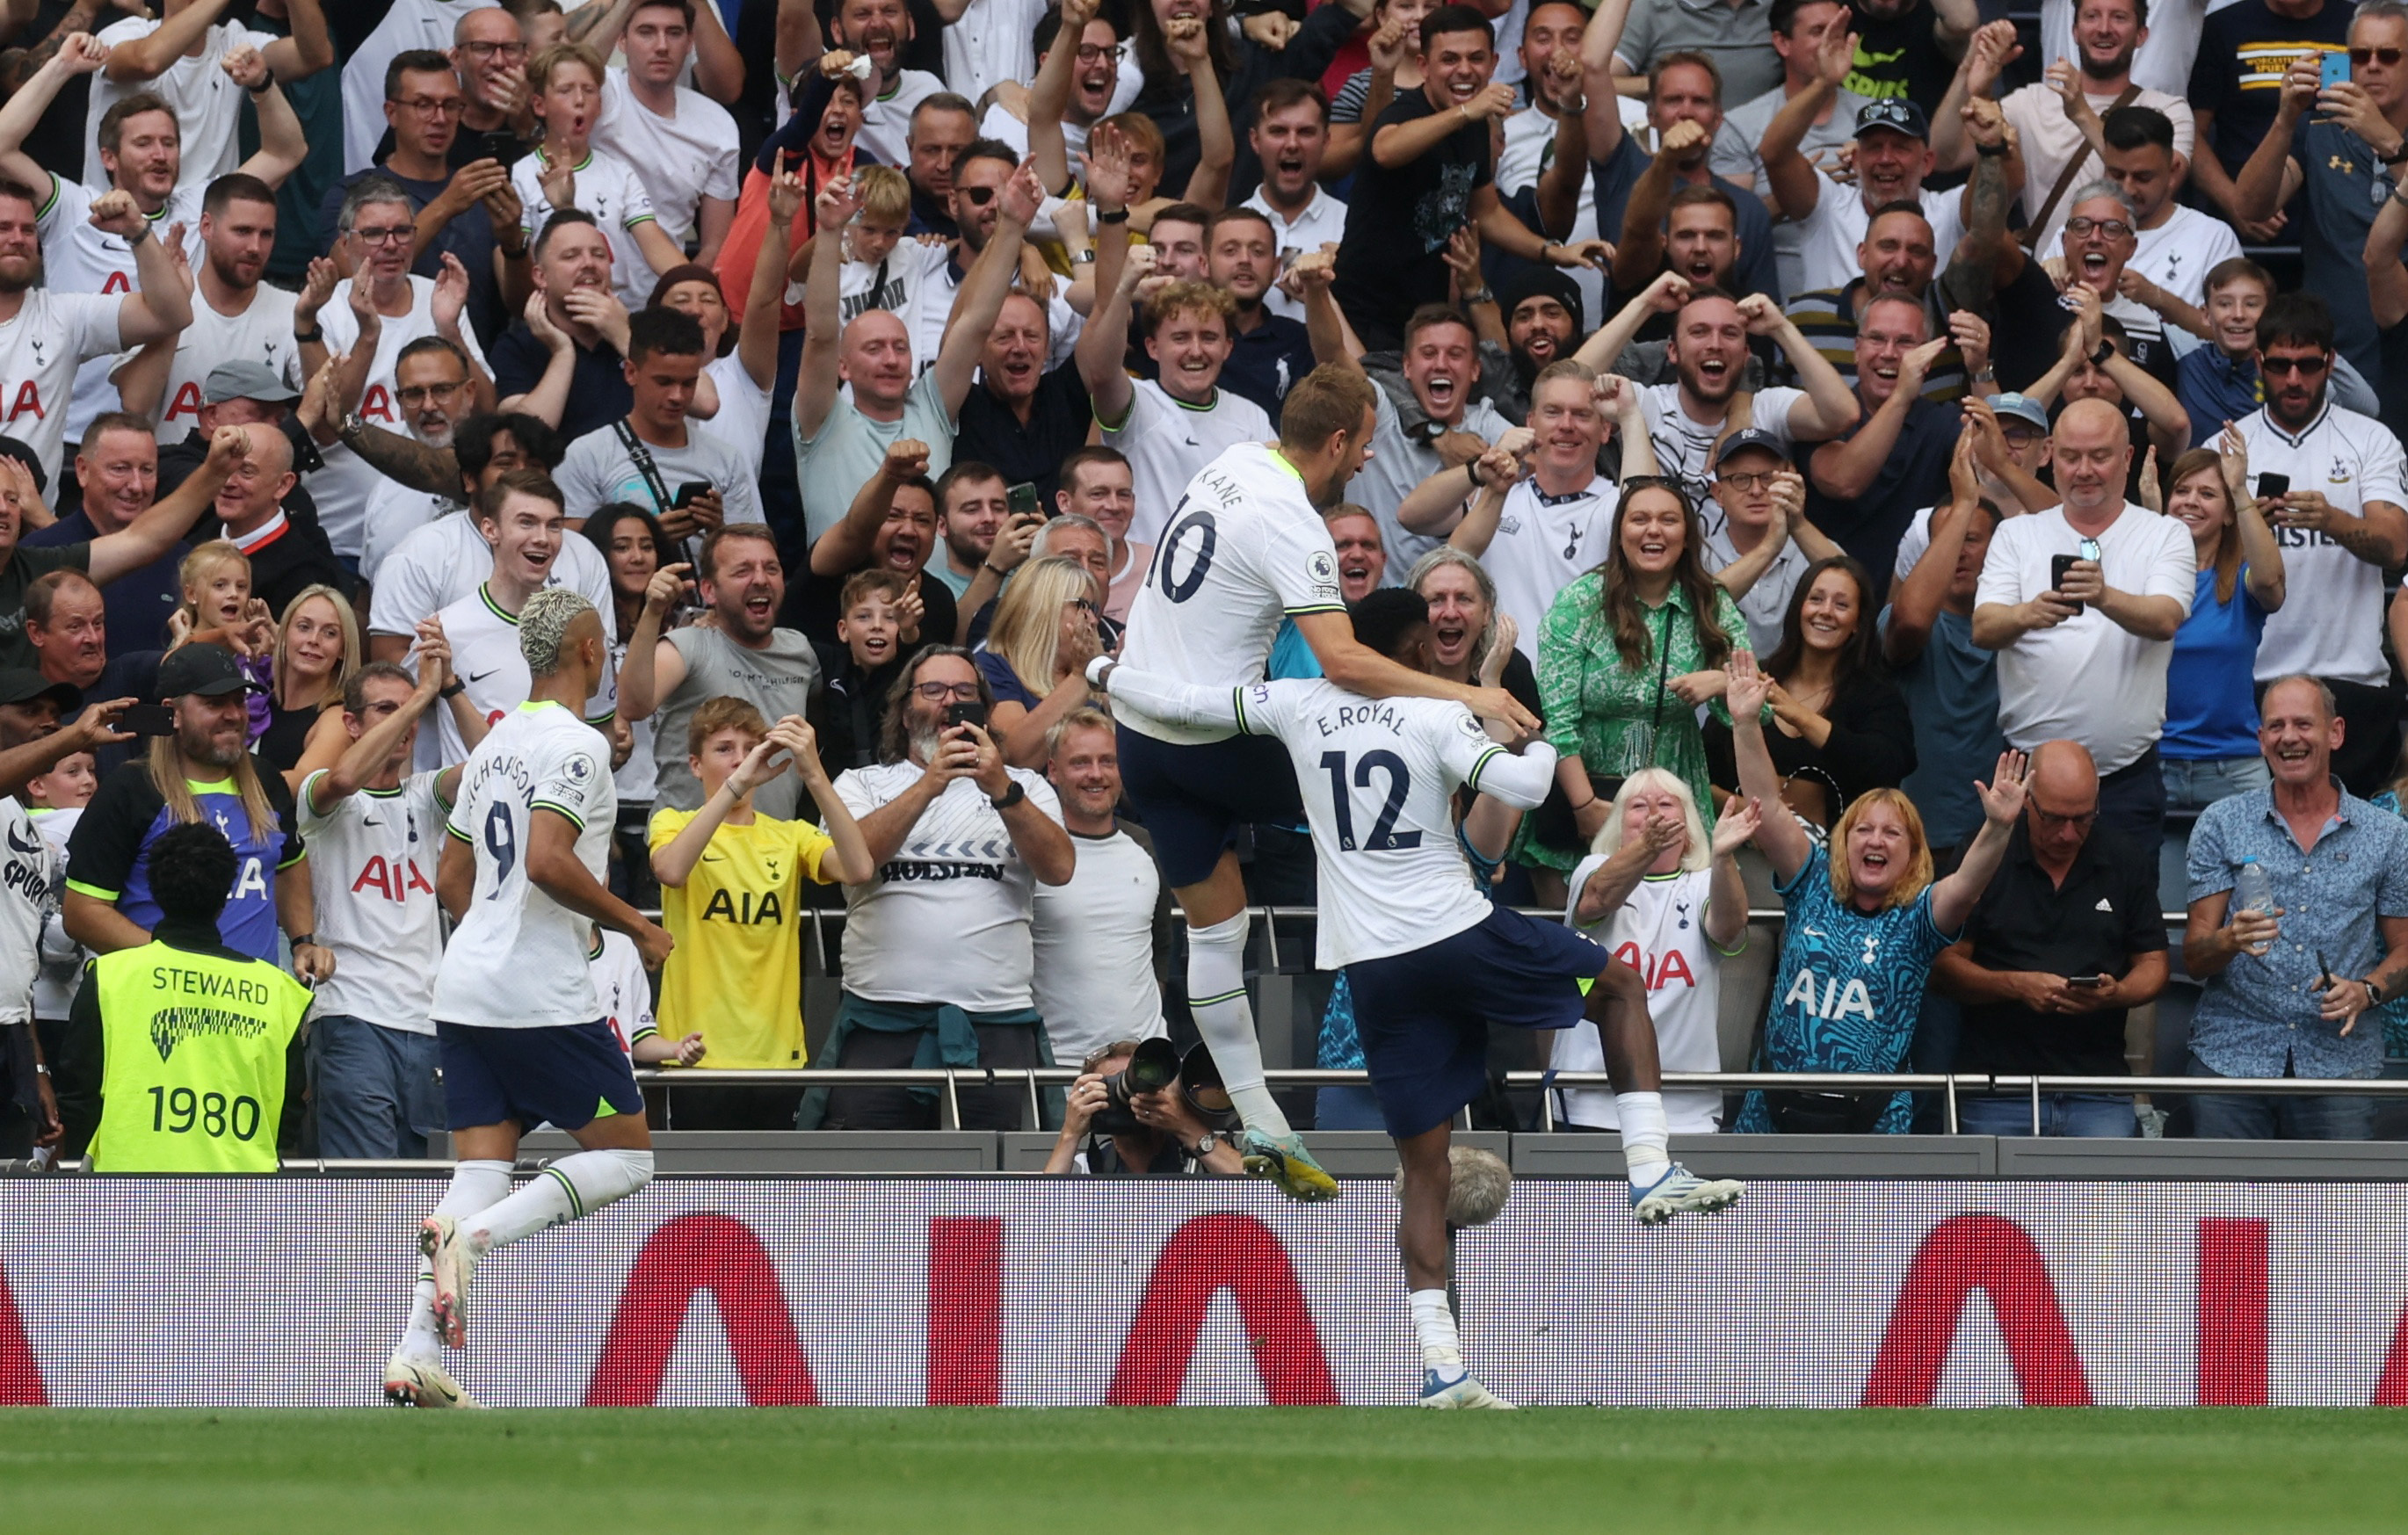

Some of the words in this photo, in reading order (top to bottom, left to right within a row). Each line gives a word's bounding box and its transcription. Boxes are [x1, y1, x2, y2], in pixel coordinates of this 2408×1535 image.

[0, 380, 44, 422] A
[1199, 468, 1242, 510] KANE
[1146, 493, 1215, 604] 10
[1317, 703, 1405, 737] E.ROYAL
[1320, 749, 1423, 852] 12
[484, 800, 516, 901] 9
[351, 855, 436, 902] AIA
[701, 888, 783, 925] AIA
[152, 967, 269, 1006] STEWARD
[1614, 940, 1695, 991] AIA
[1784, 968, 1875, 1021] AIA
[147, 1085, 261, 1142] 1980
[585, 1211, 1342, 1408] AIA
[1859, 1211, 2408, 1408] AI
